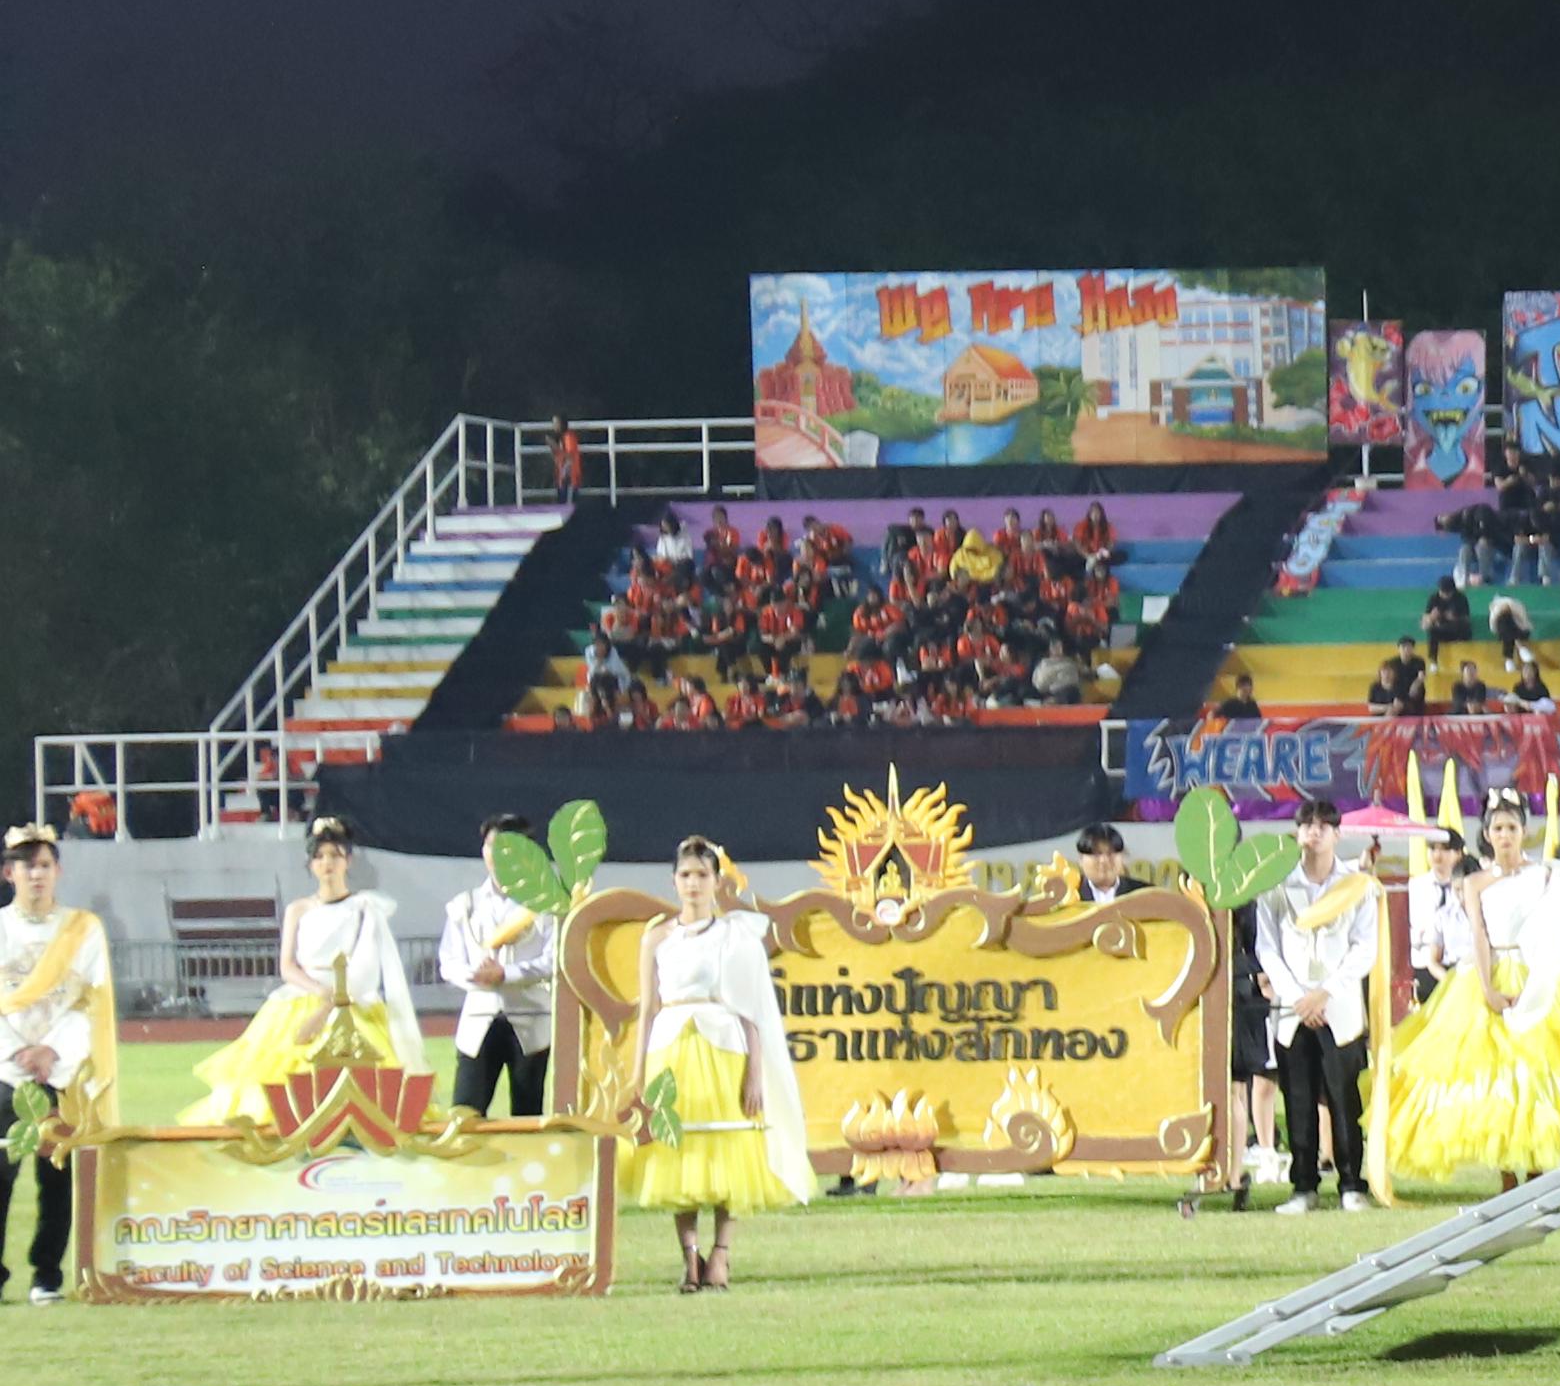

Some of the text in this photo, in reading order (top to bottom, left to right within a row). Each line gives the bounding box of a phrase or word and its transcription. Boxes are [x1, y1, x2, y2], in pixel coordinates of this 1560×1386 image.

[114, 1195, 588, 1245] คณะวิทยาศาสตร์และเทคโนโลยี
[115, 1259, 213, 1288] Faculty
[223, 1259, 251, 1282] of
[259, 1256, 366, 1282] Science
[375, 1252, 426, 1277] and
